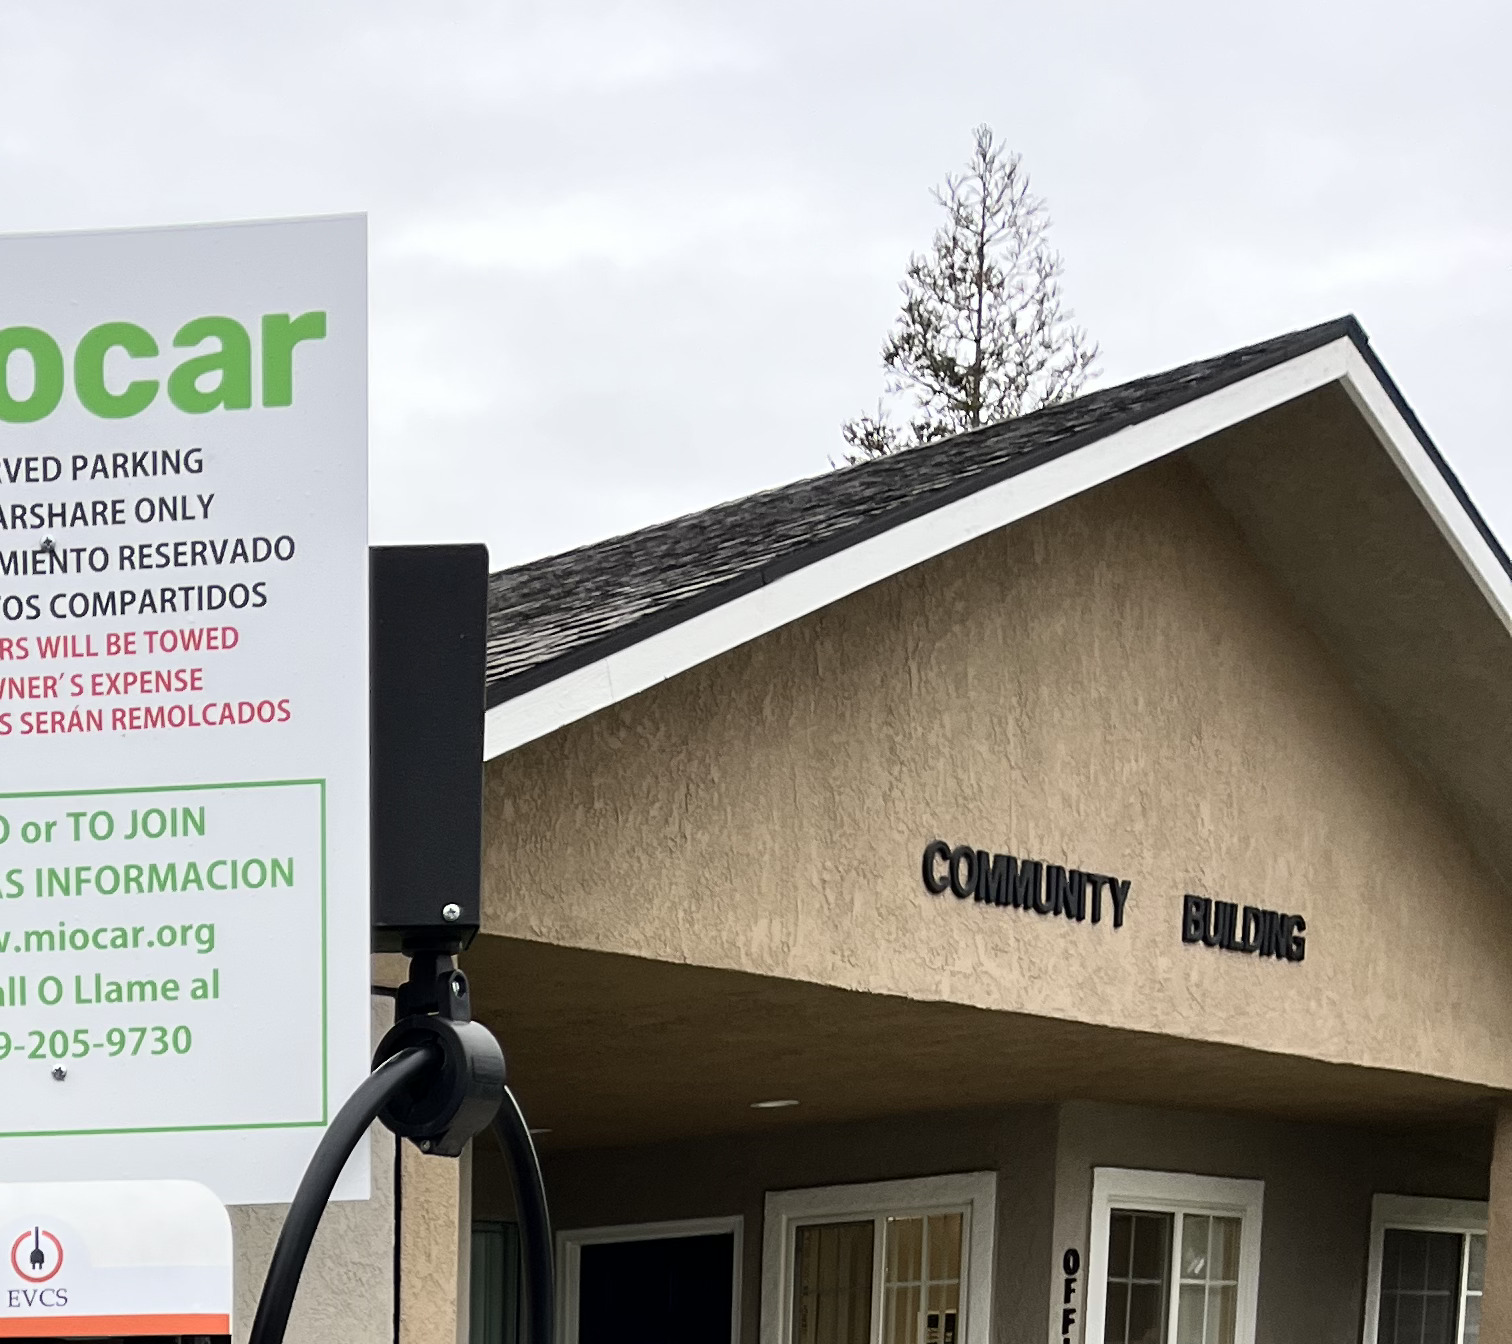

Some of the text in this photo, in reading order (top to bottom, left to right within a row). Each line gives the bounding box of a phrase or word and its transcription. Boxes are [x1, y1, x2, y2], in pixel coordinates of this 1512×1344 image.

[72, 448, 203, 481] PARKING
[135, 493, 214, 523] ONLY
[119, 535, 295, 570] RESERVADO
[50, 582, 267, 619] COMPARTIDOS
[36, 634, 98, 659] WILL
[107, 632, 136, 656] BE
[143, 627, 238, 653] TOWED
[91, 668, 203, 696] EXPENSE
[20, 705, 103, 734] SERÁN
[112, 699, 290, 730] REMOLCADOS
[21, 821, 57, 844] or
[66, 811, 114, 841] TO
[124, 806, 205, 840] JOIN
[36, 857, 293, 897] INFORMACION
[922, 840, 1306, 961] COMMUNITY BUILDING
[38, 976, 63, 1005] O
[75, 973, 180, 1004] Llame
[191, 968, 219, 1000] al
[8, 1288, 68, 1308] EVCS
